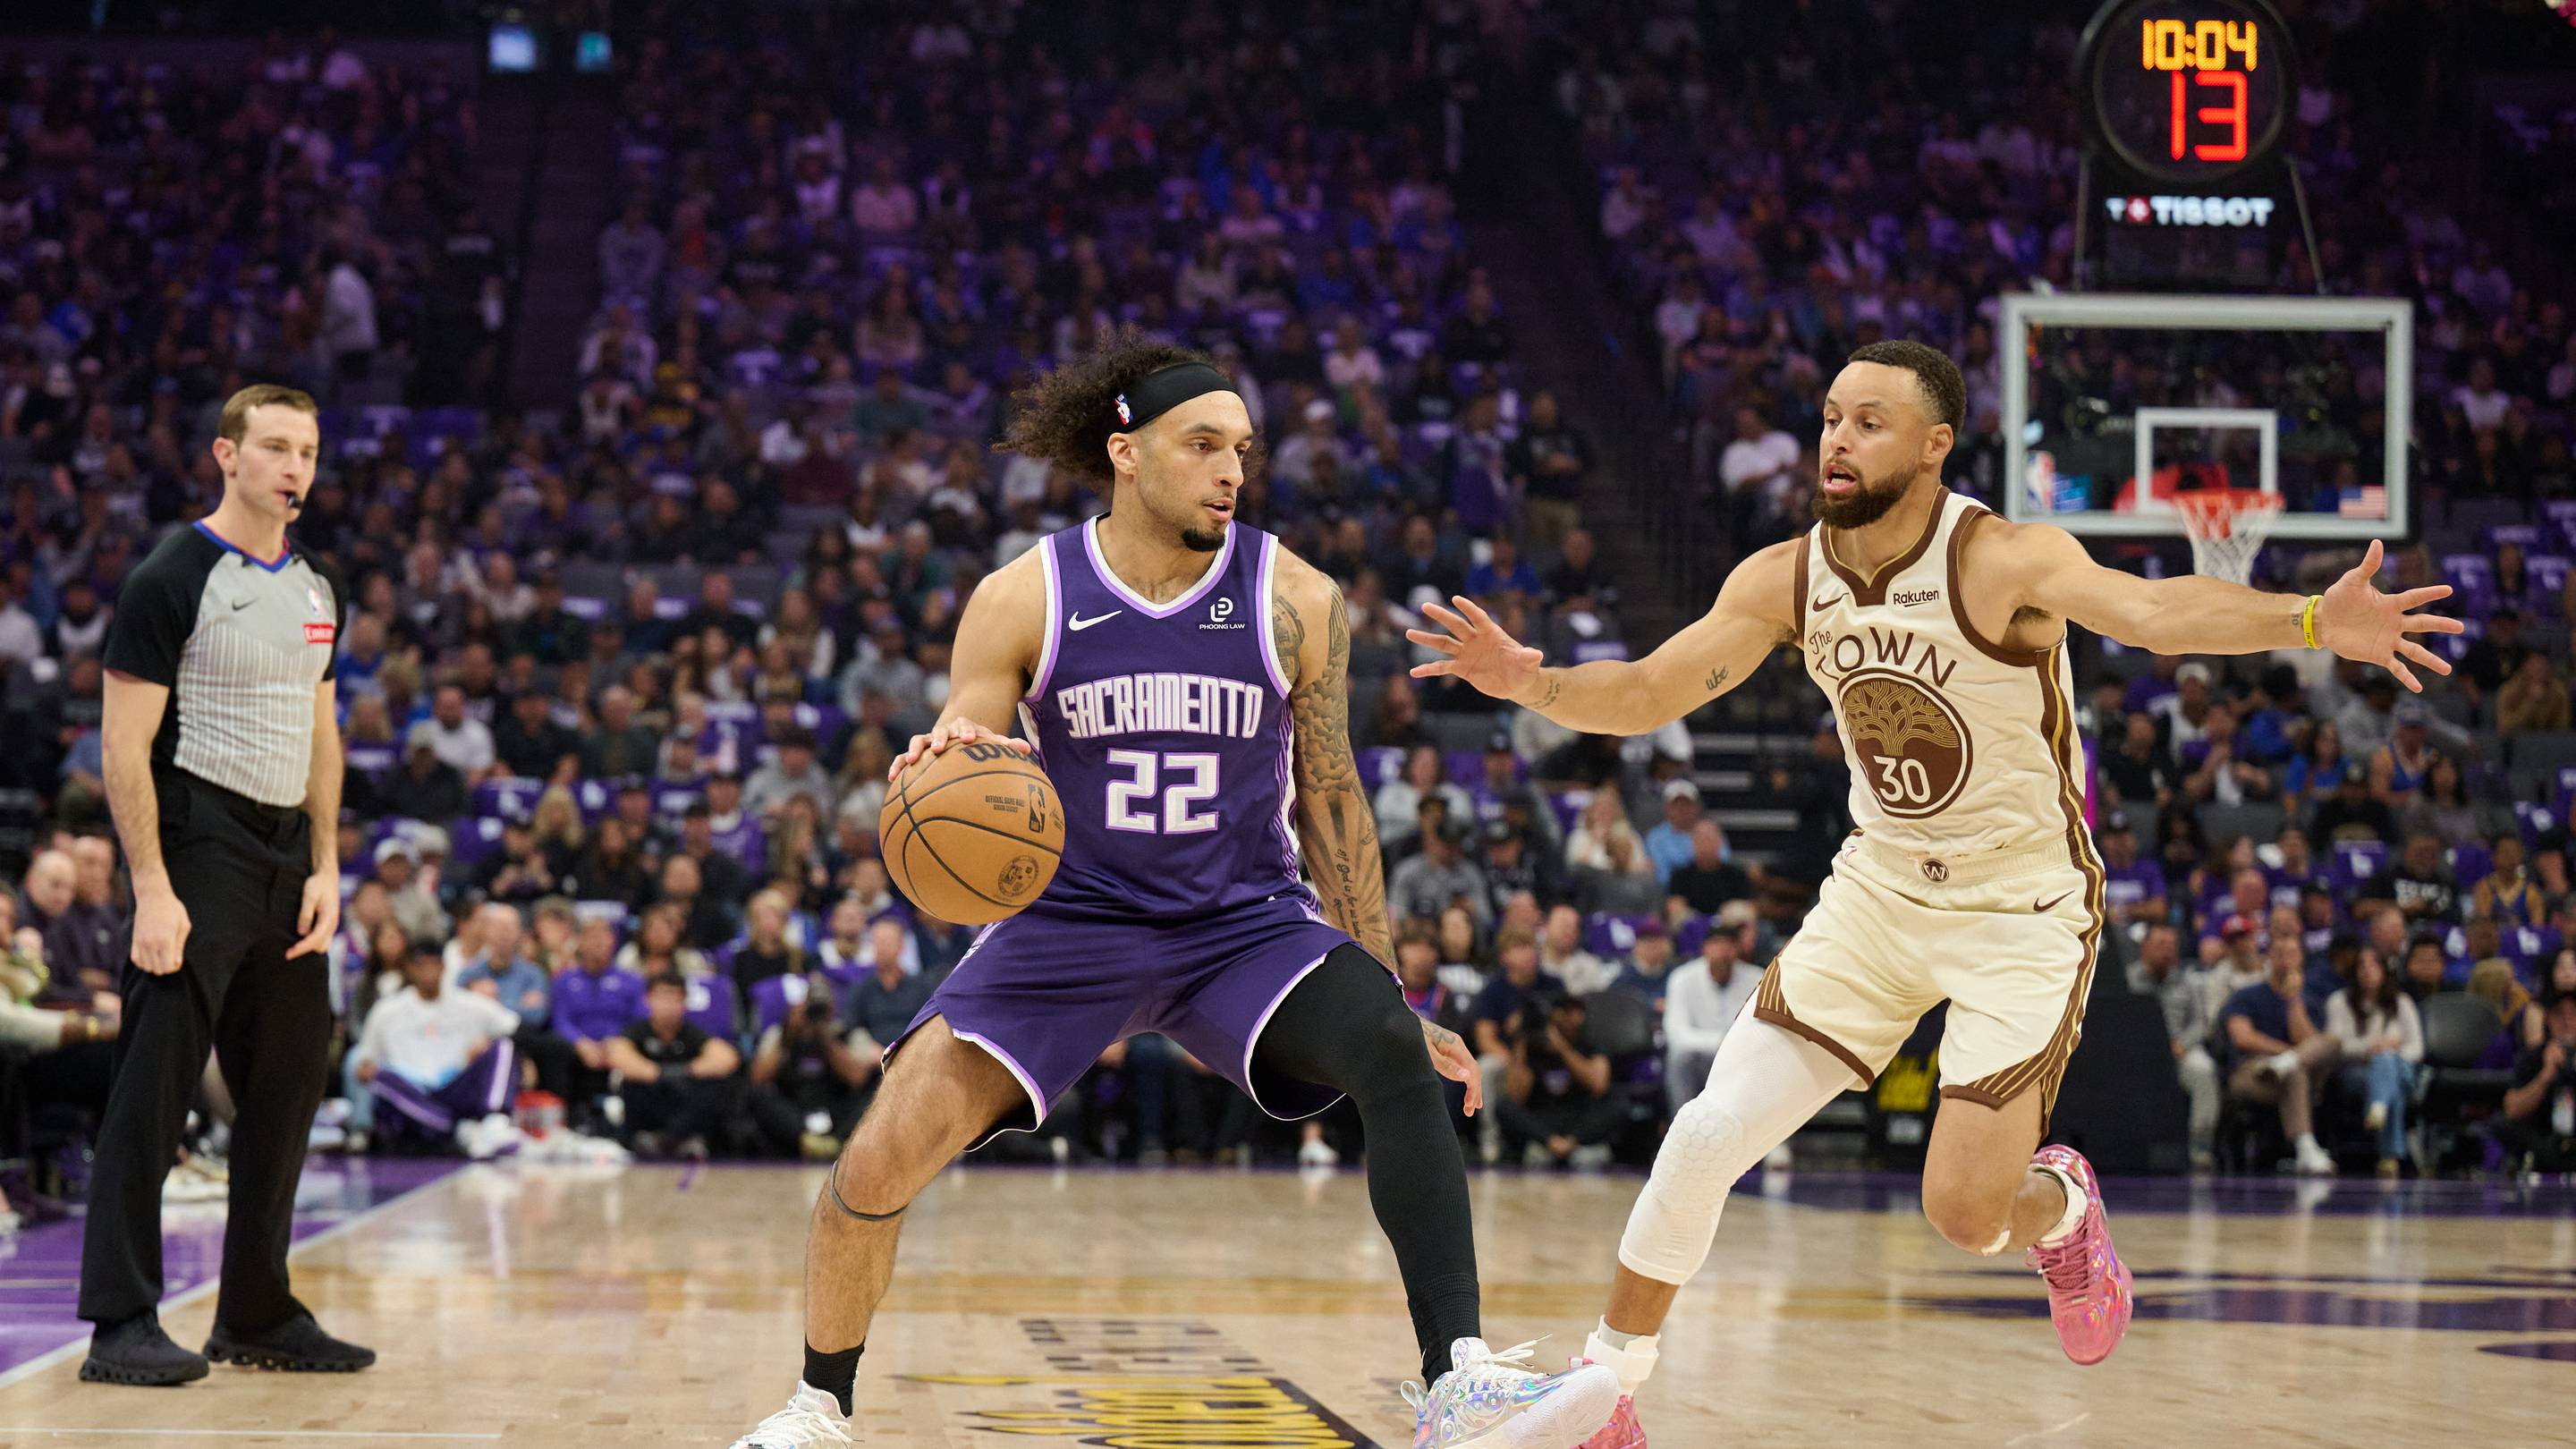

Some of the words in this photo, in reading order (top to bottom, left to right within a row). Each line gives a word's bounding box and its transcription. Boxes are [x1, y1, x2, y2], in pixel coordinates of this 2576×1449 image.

[2142, 19, 2258, 72] 10:04
[2170, 71, 2248, 162] 13
[2149, 195, 2275, 227] TISSOT
[1893, 589, 1939, 607] Rakuten
[1809, 630, 1834, 655] The
[1815, 626, 1957, 689] TOWN
[1056, 673, 1264, 739] SACRAMENTO
[1105, 748, 1220, 835] 22
[1873, 755, 1931, 804] 30
